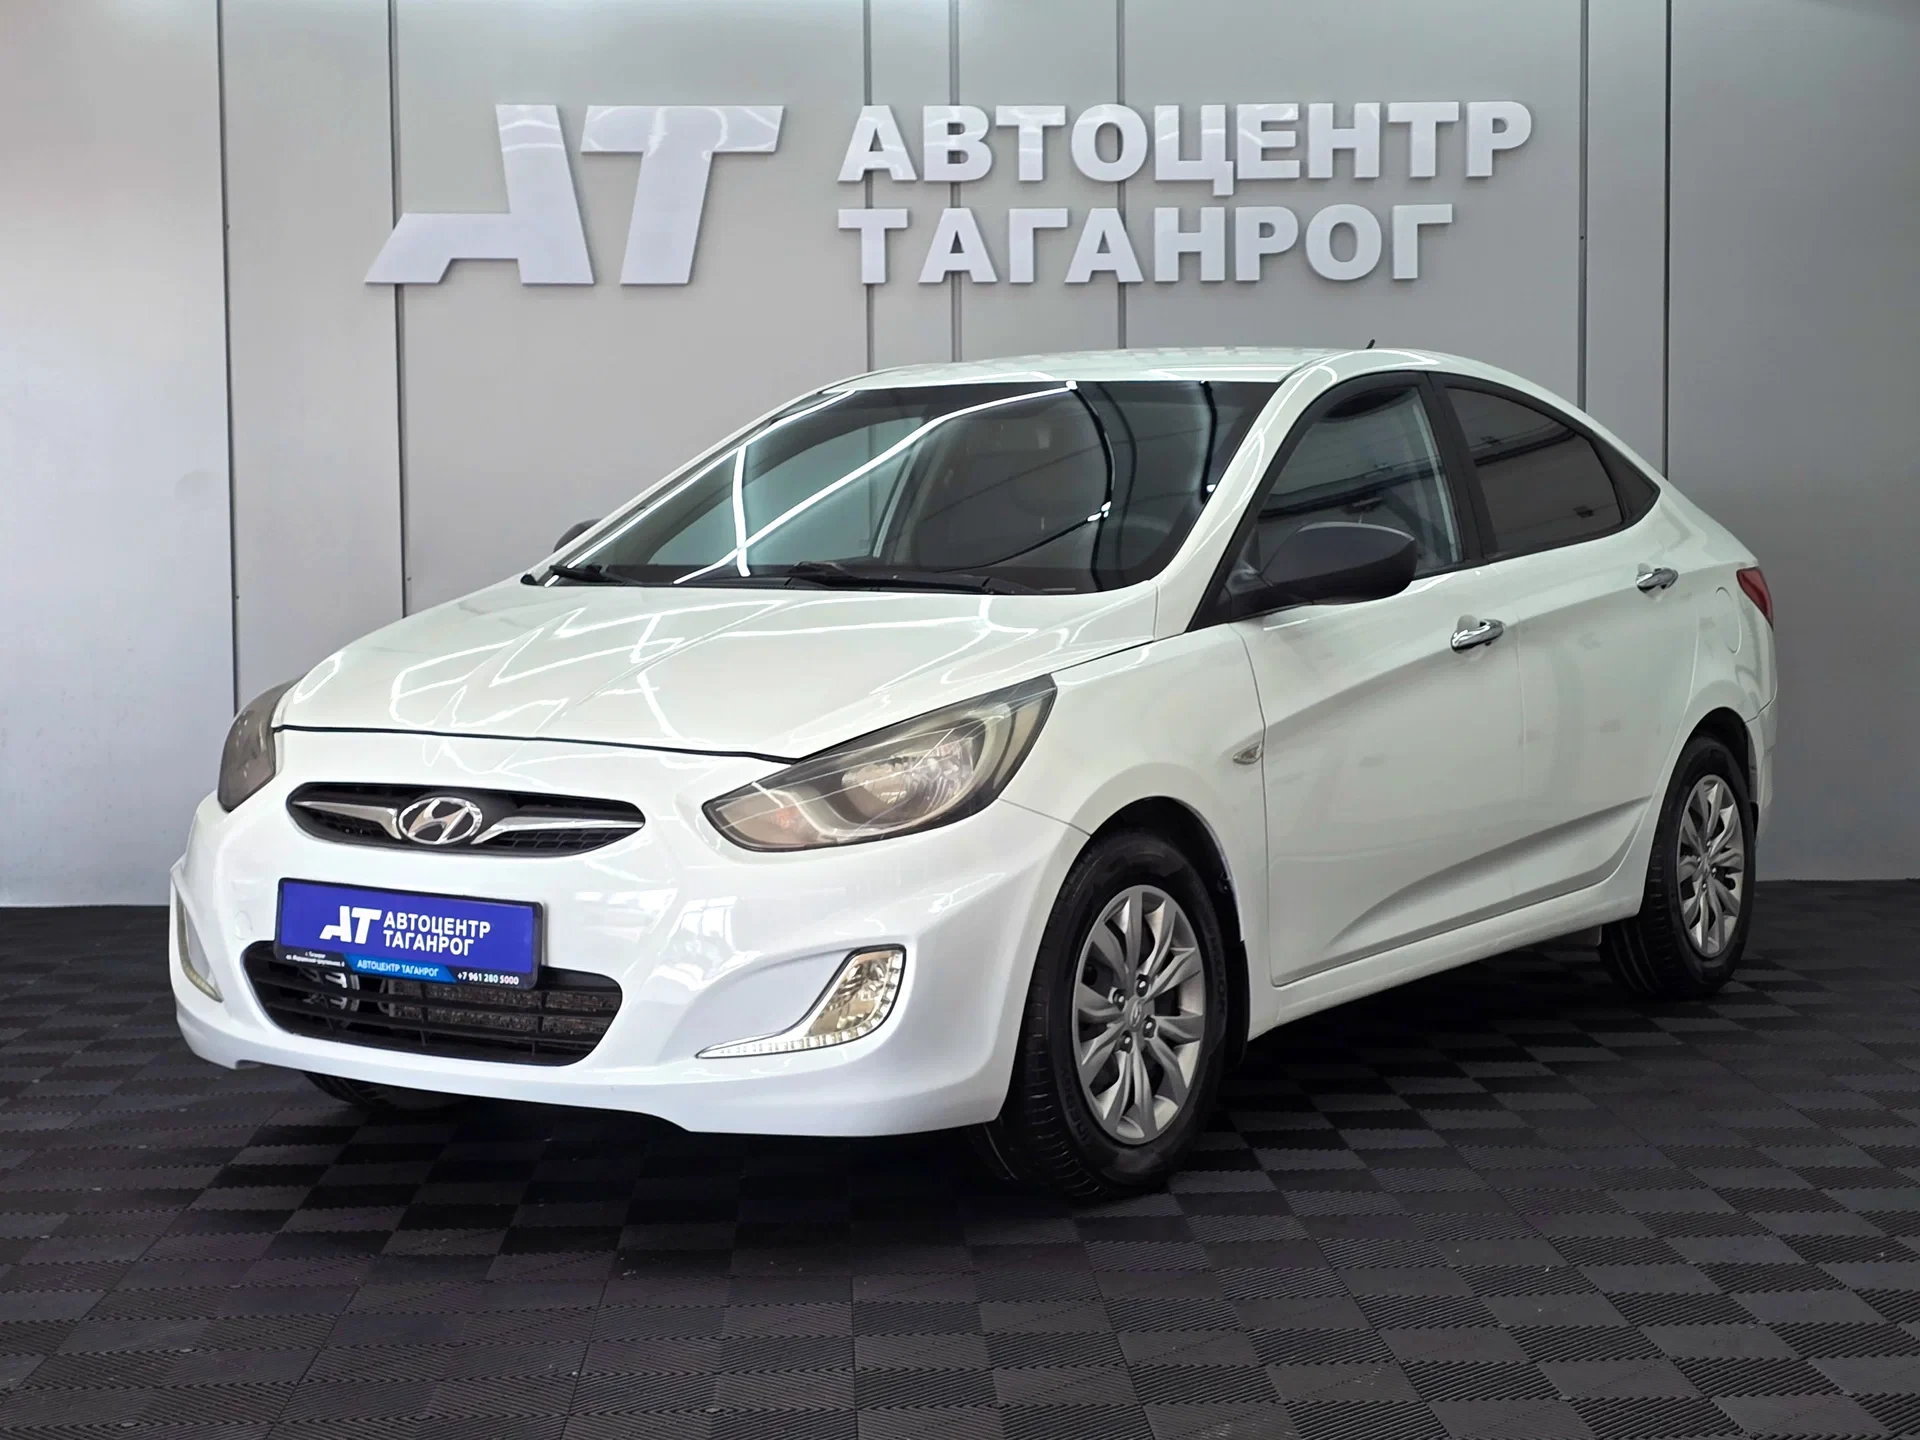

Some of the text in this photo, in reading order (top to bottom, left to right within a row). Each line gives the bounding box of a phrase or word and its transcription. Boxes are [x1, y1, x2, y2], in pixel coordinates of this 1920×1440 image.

[837, 101, 1532, 196] АВТОЦЕНТР
[364, 104, 784, 285] АТ
[838, 204, 1453, 284] ТАГАНРОГ
[383, 911, 491, 939] АВТОЦЕНТР
[384, 929, 474, 957] ТАГАНРОГ
[357, 959, 400, 973] АВТОЦЕНТР
[401, 964, 440, 977] ТАГАНРОГ
[457, 971, 467, 981] +7
[499, 974, 519, 985] 5000
